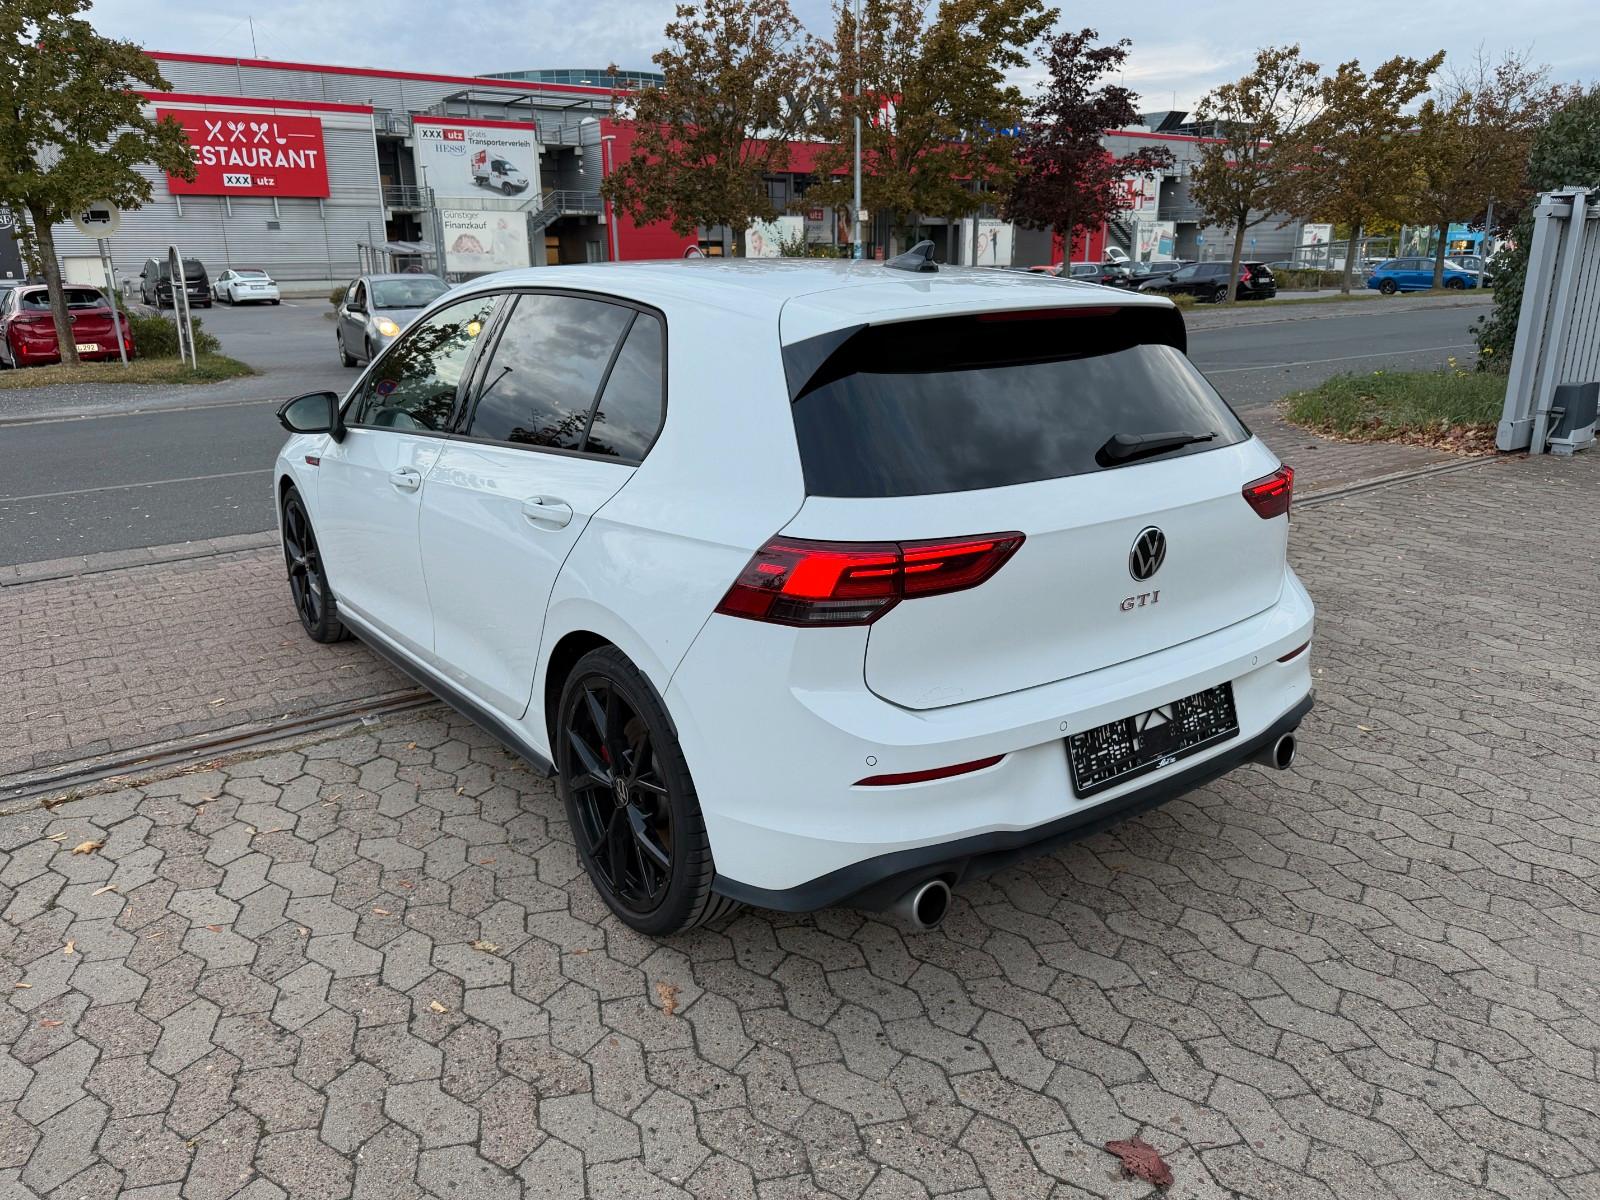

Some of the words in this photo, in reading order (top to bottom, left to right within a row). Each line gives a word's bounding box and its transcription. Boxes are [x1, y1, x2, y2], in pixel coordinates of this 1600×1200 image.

[435, 143, 466, 154] HESSE
[468, 138, 530, 148] Transporterverleih
[188, 145, 318, 169] ESTAURANT
[444, 220, 487, 230] Finanzkauf
[1119, 589, 1161, 611] GTI
